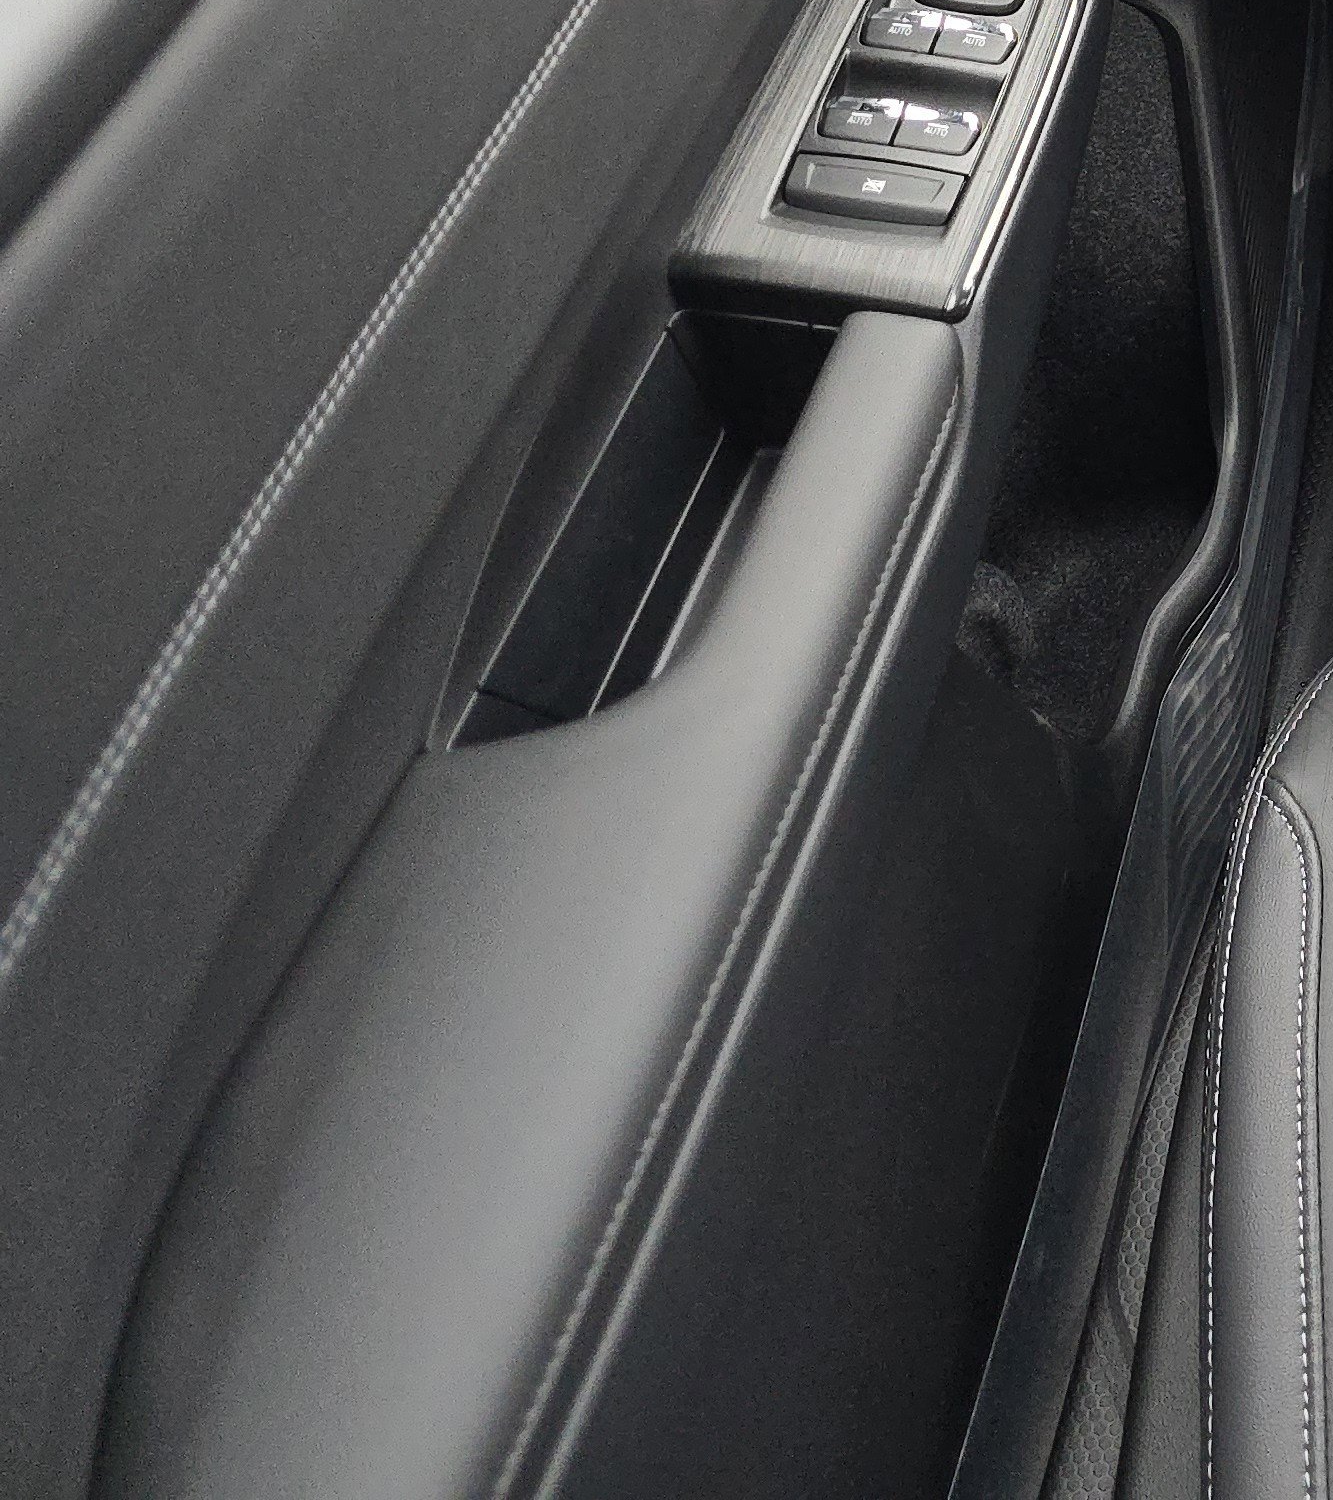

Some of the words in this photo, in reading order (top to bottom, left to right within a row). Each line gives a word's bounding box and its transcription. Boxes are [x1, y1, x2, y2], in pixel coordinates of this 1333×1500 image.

[888, 25, 913, 36] AUTO
[963, 35, 987, 47] AUTO
[847, 115, 873, 126] AUTO
[923, 127, 949, 137] AUTO
